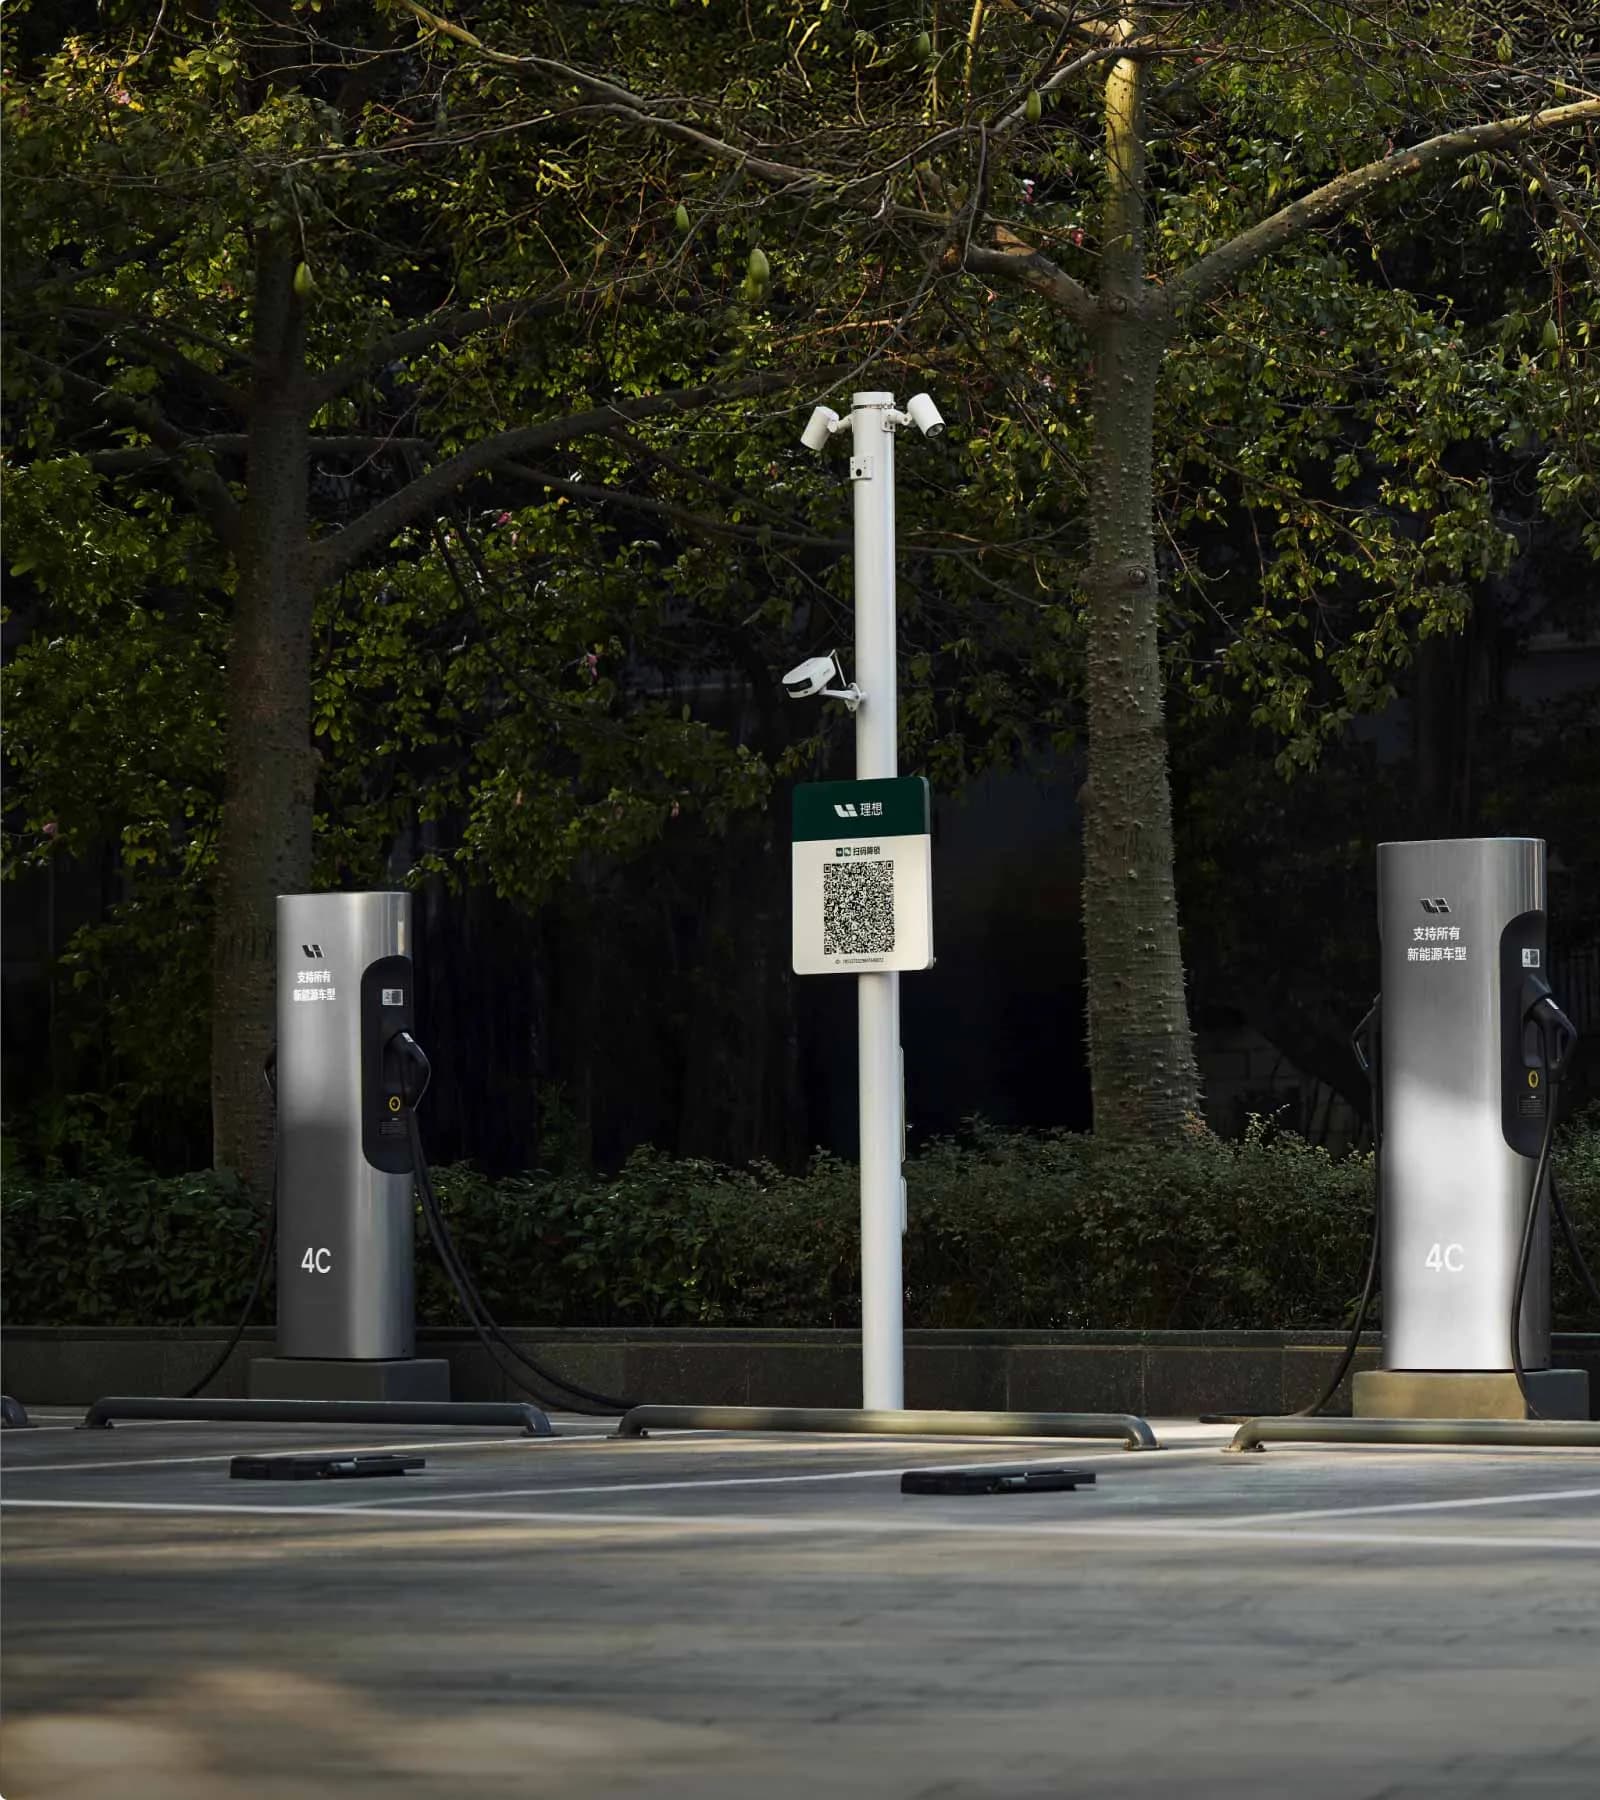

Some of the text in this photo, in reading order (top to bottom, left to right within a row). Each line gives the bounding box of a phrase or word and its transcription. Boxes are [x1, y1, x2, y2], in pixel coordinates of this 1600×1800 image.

[860, 802, 883, 817] 理想
[1413, 926, 1461, 942] 支持所有
[1407, 946, 1467, 962] 新能源车型
[296, 970, 332, 984] 支持所有
[301, 1247, 332, 1274] 4C
[1425, 1244, 1465, 1272] 4C
